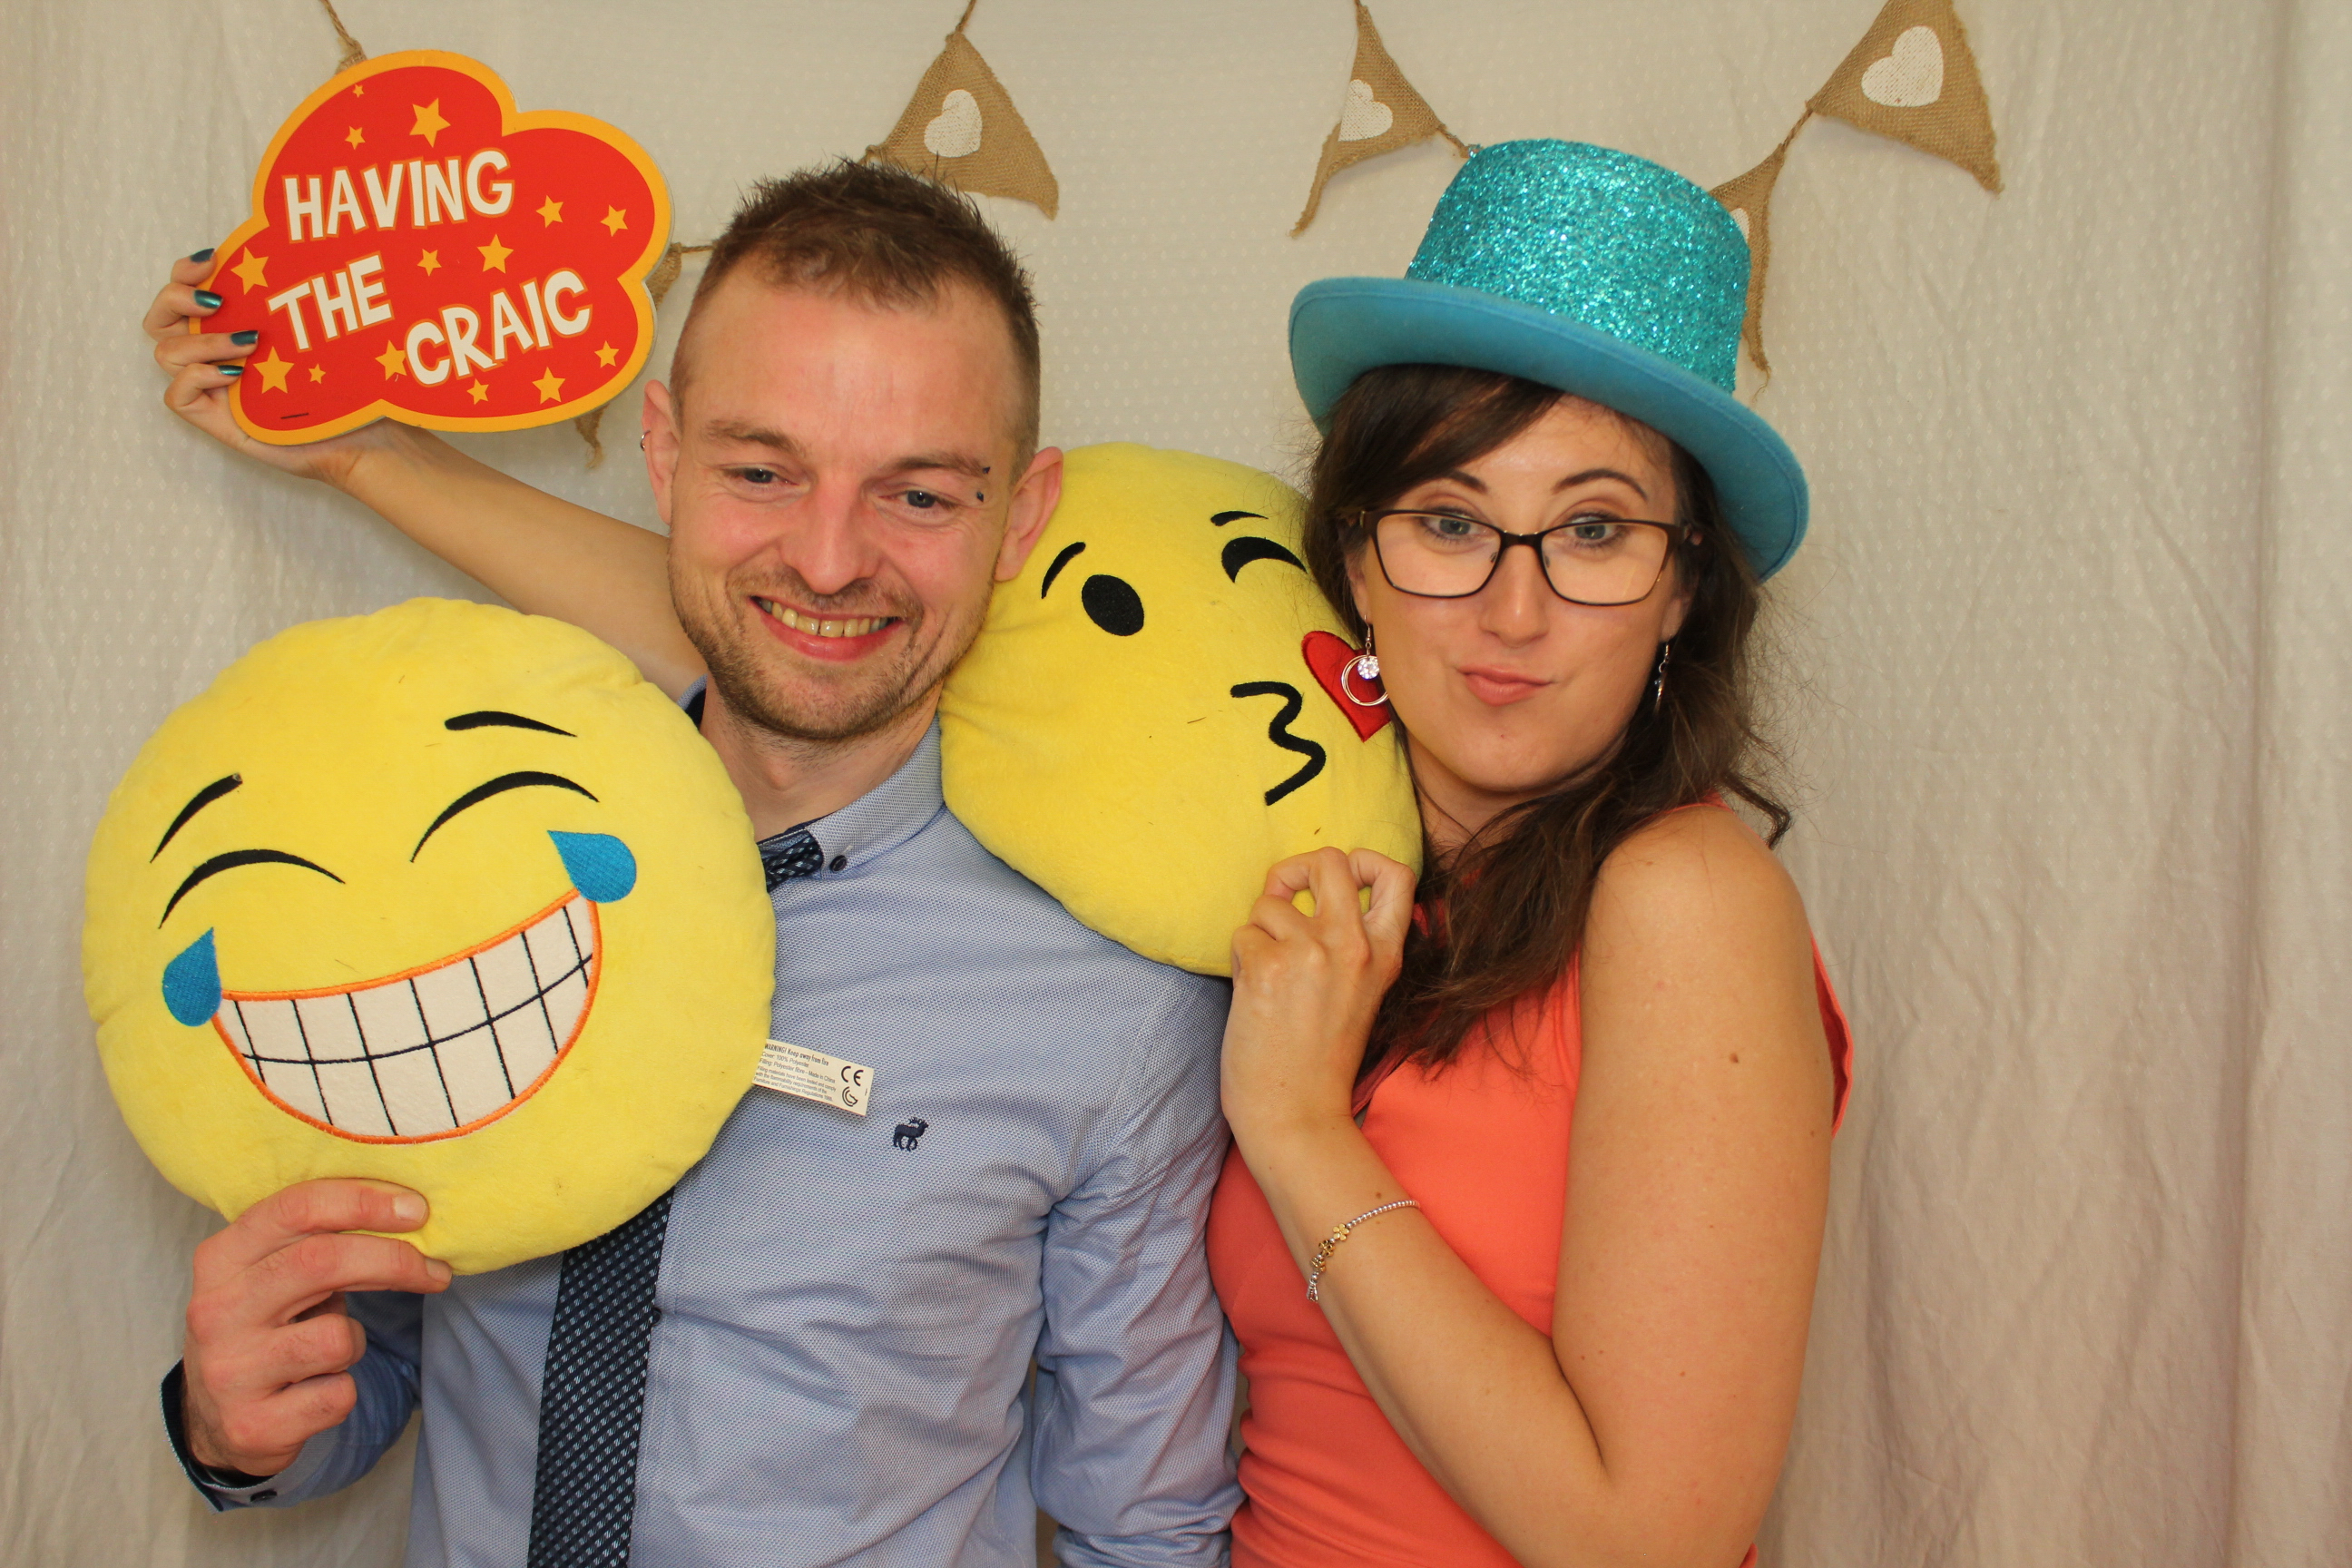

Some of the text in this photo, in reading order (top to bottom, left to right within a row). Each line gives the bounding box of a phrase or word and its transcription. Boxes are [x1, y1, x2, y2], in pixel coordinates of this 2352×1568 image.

[283, 148, 514, 241] HAVING
[267, 256, 392, 351] THE
[405, 269, 592, 385] CRAIC
[774, 1062, 794, 1071] Polyester
[808, 1070, 819, 1079] Made
[824, 1075, 836, 1084] China
[776, 1054, 789, 1063] 100%
[789, 1058, 809, 1068] Polyester
[788, 1048, 799, 1057] Keep
[799, 1054, 811, 1062] away
[811, 1054, 821, 1063] from
[821, 1057, 829, 1066] fire
